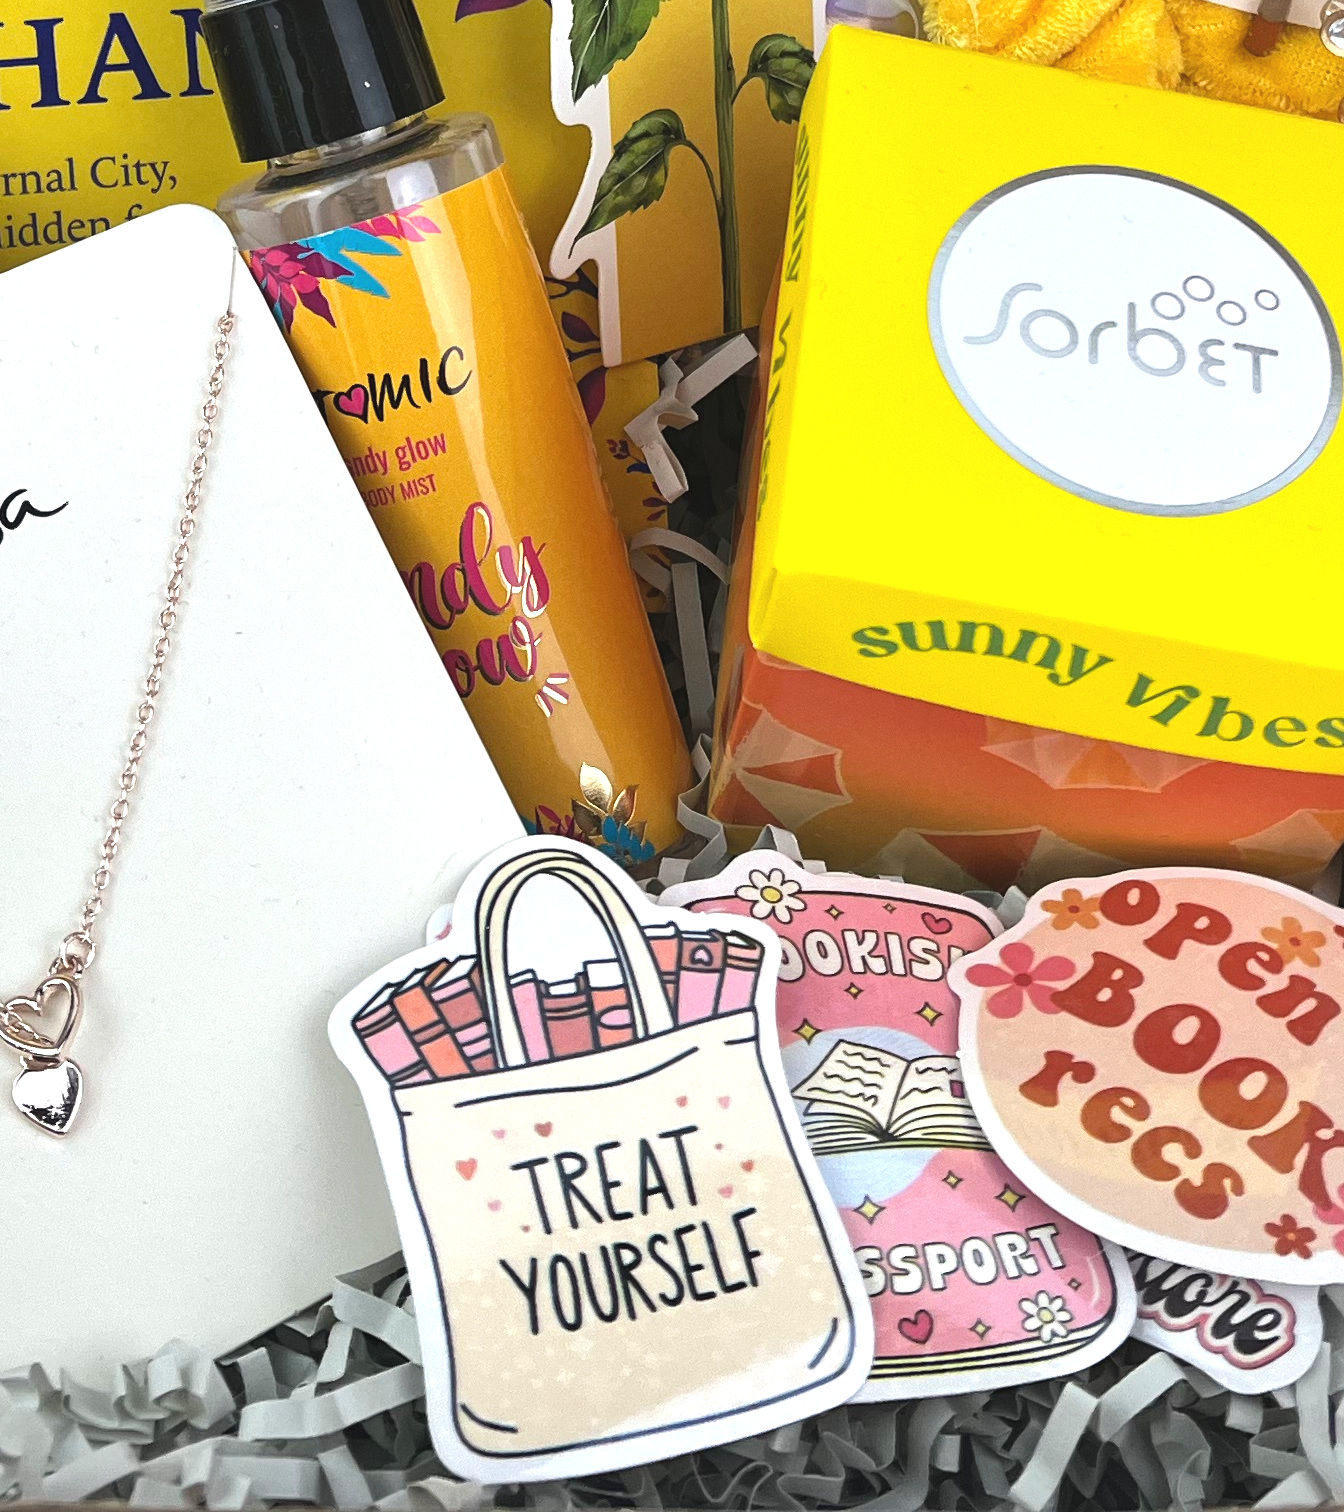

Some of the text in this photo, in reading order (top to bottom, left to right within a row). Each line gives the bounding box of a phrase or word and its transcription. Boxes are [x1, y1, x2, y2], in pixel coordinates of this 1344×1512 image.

[90, 153, 177, 194] City,
[395, 433, 446, 472] glow
[400, 474, 436, 502] MIST
[852, 618, 1115, 686] sunny
[1019, 1050, 1245, 1220] recs
[510, 1125, 699, 1235] TREAT
[499, 1207, 761, 1335] YOURSELF
[856, 1223, 1065, 1296] SSPORT
